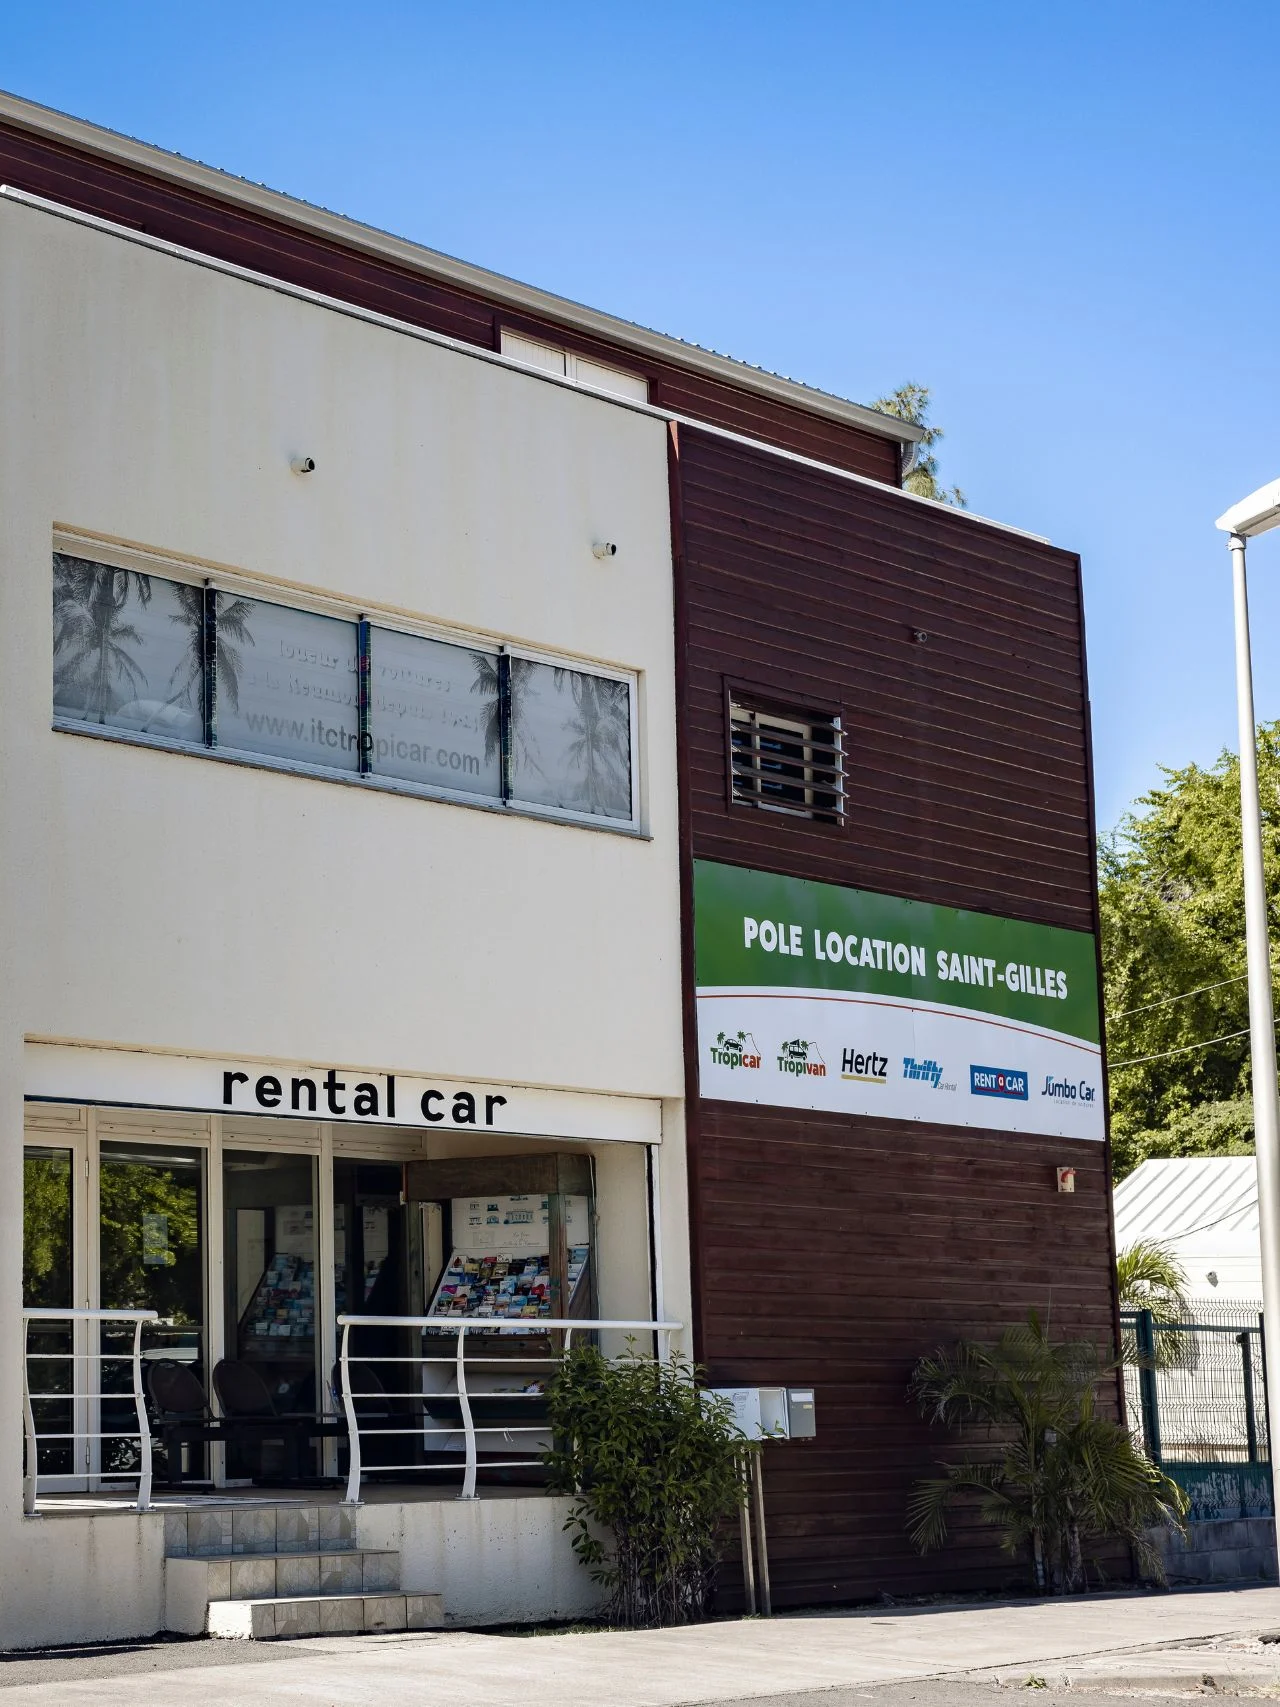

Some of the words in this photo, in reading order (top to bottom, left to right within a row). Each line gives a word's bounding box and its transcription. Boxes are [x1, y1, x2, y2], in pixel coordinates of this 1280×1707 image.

[246, 712, 480, 776] www.itctropicar.com
[743, 916, 803, 957] POLE
[814, 929, 926, 977] LOCATION
[936, 950, 1068, 1000] SAINT-GILLES
[710, 1048, 761, 1070] Tropicar
[777, 1056, 826, 1077] Tropivan
[842, 1048, 888, 1077] Hertz
[903, 1057, 943, 1089] Thrifty
[974, 1072, 996, 1089] RENT
[1006, 1076, 1024, 1092] CAR
[1041, 1075, 1076, 1099] Jumbo
[1080, 1080, 1095, 1101] Car
[222, 1069, 395, 1118] rental
[421, 1089, 508, 1126] car
